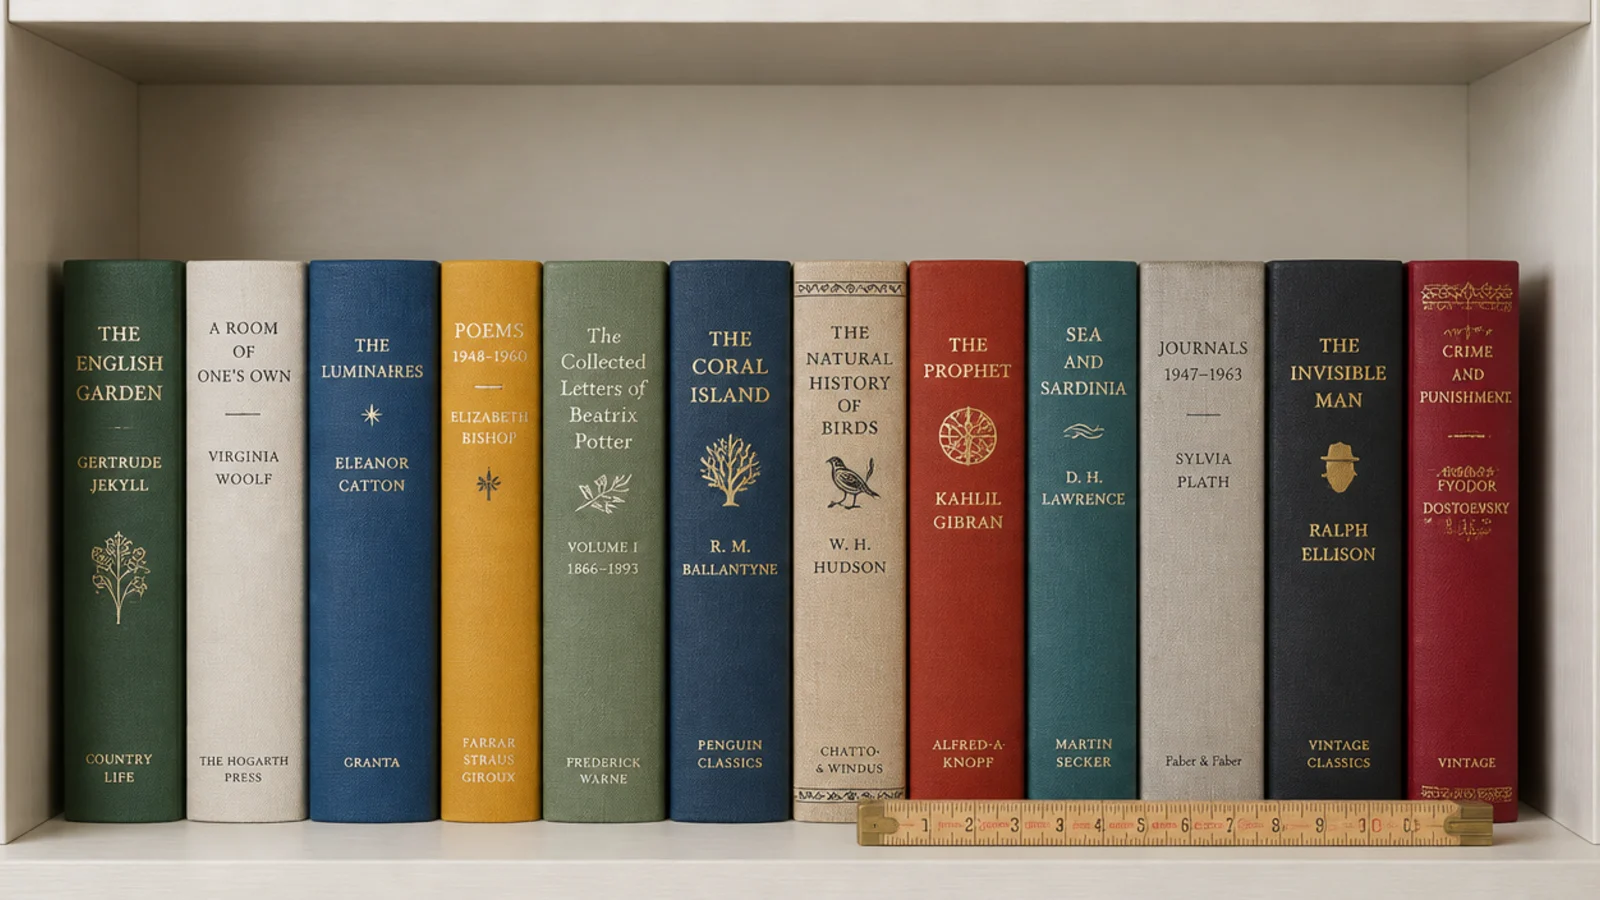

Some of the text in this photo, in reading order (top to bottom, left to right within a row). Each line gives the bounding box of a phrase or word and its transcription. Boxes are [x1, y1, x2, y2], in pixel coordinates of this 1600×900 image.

[98, 327, 140, 342] THE
[210, 322, 278, 334] A ROOM
[455, 323, 524, 338] POEMS
[831, 326, 869, 339] THE
[1066, 327, 1102, 342] SEA
[588, 328, 620, 344] The
[709, 331, 752, 346] THE
[233, 345, 255, 358] OF
[355, 339, 390, 352] THE
[949, 338, 987, 352] THE
[1158, 342, 1248, 356] JOURNALS
[1320, 339, 1359, 353] THE
[1443, 345, 1493, 358] CRIME
[76, 356, 163, 371] ENGLISH
[561, 354, 646, 370] Collected
[806, 352, 893, 365] NATURAL
[1064, 355, 1103, 368] AND
[692, 359, 768, 374] CORAL
[924, 364, 1011, 378] PROPHET
[1291, 366, 1386, 380] INVISIBLE
[198, 370, 291, 382] ONE'S OWN
[1452, 368, 1484, 381] AND
[809, 376, 890, 390] HISTORY
[1041, 382, 1127, 395] SARDINIA
[76, 386, 162, 401] GARDEN
[560, 380, 648, 400] Letters of
[690, 387, 770, 403] ISLAND
[838, 399, 861, 412] OF
[1315, 393, 1362, 408] MAN
[451, 412, 528, 423] ELIZABETH
[570, 407, 638, 423] Beatrix
[821, 421, 878, 435] BIRDS
[462, 432, 517, 444] BISHOP
[575, 433, 632, 449] Potter
[78, 457, 161, 468] GERTRUDE
[209, 451, 279, 462] VIRGINIA
[335, 457, 409, 469] ELEANOR
[1176, 453, 1232, 464] SYLVIA
[216, 474, 272, 485] WOOLF
[1066, 472, 1102, 483] D. H.
[1177, 476, 1229, 488] PLATH
[90, 479, 148, 494] JEKYLL
[339, 480, 405, 492] CATTON
[1438, 480, 1497, 493] FYODOR
[936, 492, 1001, 505] KAHLIL
[1042, 494, 1125, 505] LAWRENCE
[1423, 502, 1510, 514] DOSTOEVSKY
[933, 516, 1003, 529] GIBRAN
[1309, 524, 1368, 537] RALPH
[568, 542, 638, 552] VOLUME I
[710, 541, 751, 553] R. M.
[830, 538, 870, 551] W. H.
[1302, 548, 1376, 561] ELLISON
[683, 564, 778, 575] BALLANTYNE
[814, 562, 886, 573] HUDSON
[463, 738, 516, 748] FARRAR
[698, 740, 762, 750] PENGUIN
[1056, 738, 1112, 750] MARTIN
[1309, 740, 1369, 751] VINTAGE
[86, 754, 152, 765] COUNTRY
[200, 756, 289, 767] THE HOGARTH
[463, 755, 515, 765] STRAUS
[567, 758, 640, 768] FREDERICK
[698, 758, 762, 768] CLASSICS
[943, 756, 994, 768] KNOPF
[1056, 756, 1111, 768] SECKER
[1166, 756, 1242, 767] Faber & Faber
[1307, 757, 1370, 768] CLASSICS
[1438, 758, 1496, 768] VINTAGE
[815, 763, 883, 774] & WINDUS
[104, 772, 134, 783] LIFE
[225, 773, 262, 783] PRESS
[462, 772, 516, 783] GIROUX
[580, 774, 627, 784] WARNE
[965, 818, 973, 832] 2
[1010, 818, 1019, 833] 3
[1055, 818, 1064, 833] 3
[1181, 818, 1189, 833] 6
[1272, 818, 1280, 833] 8
[1316, 818, 1324, 833] 9
